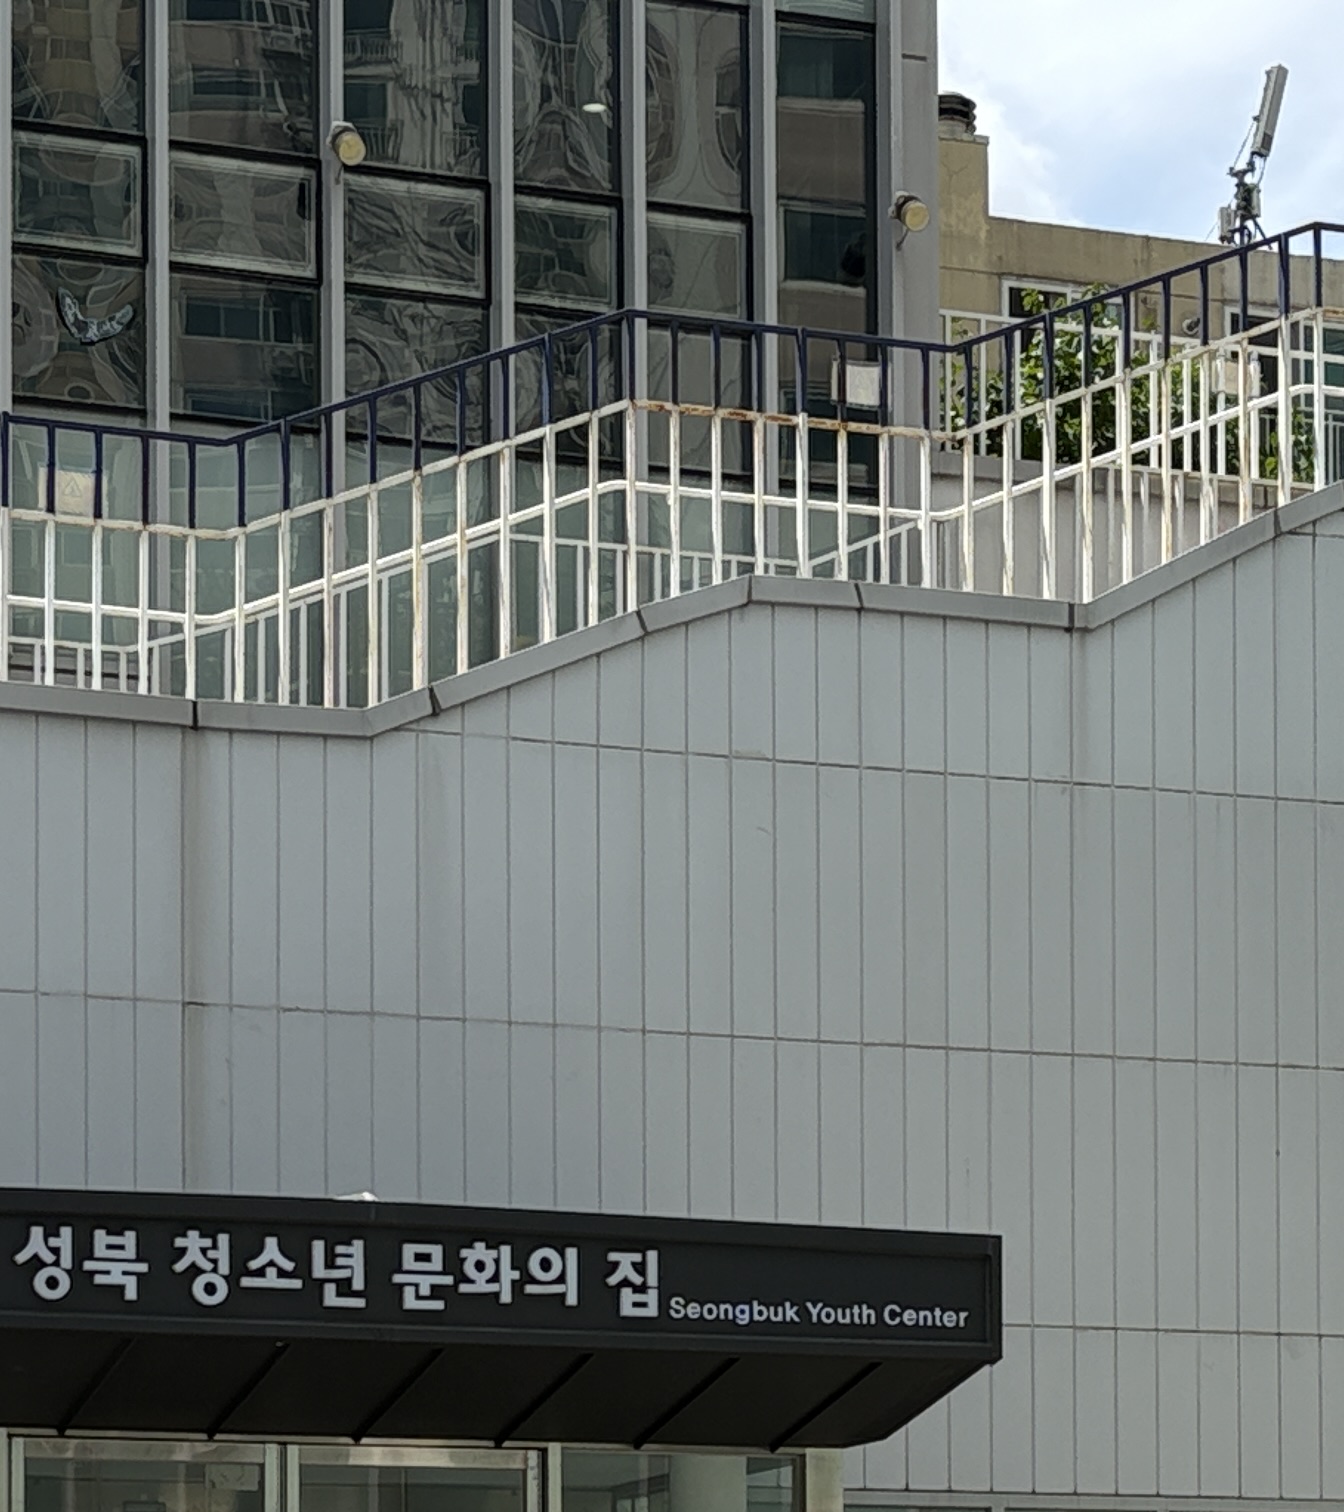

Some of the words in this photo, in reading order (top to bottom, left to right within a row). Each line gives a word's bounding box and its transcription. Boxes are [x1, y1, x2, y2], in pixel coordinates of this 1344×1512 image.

[14, 1225, 149, 1301] 성북
[171, 1230, 367, 1308] 청소년
[391, 1242, 578, 1310] 문화의
[605, 1249, 660, 1318] 집
[668, 1298, 800, 1326] Seongbuk
[805, 1302, 877, 1326] Youth
[882, 1305, 968, 1329] Center
